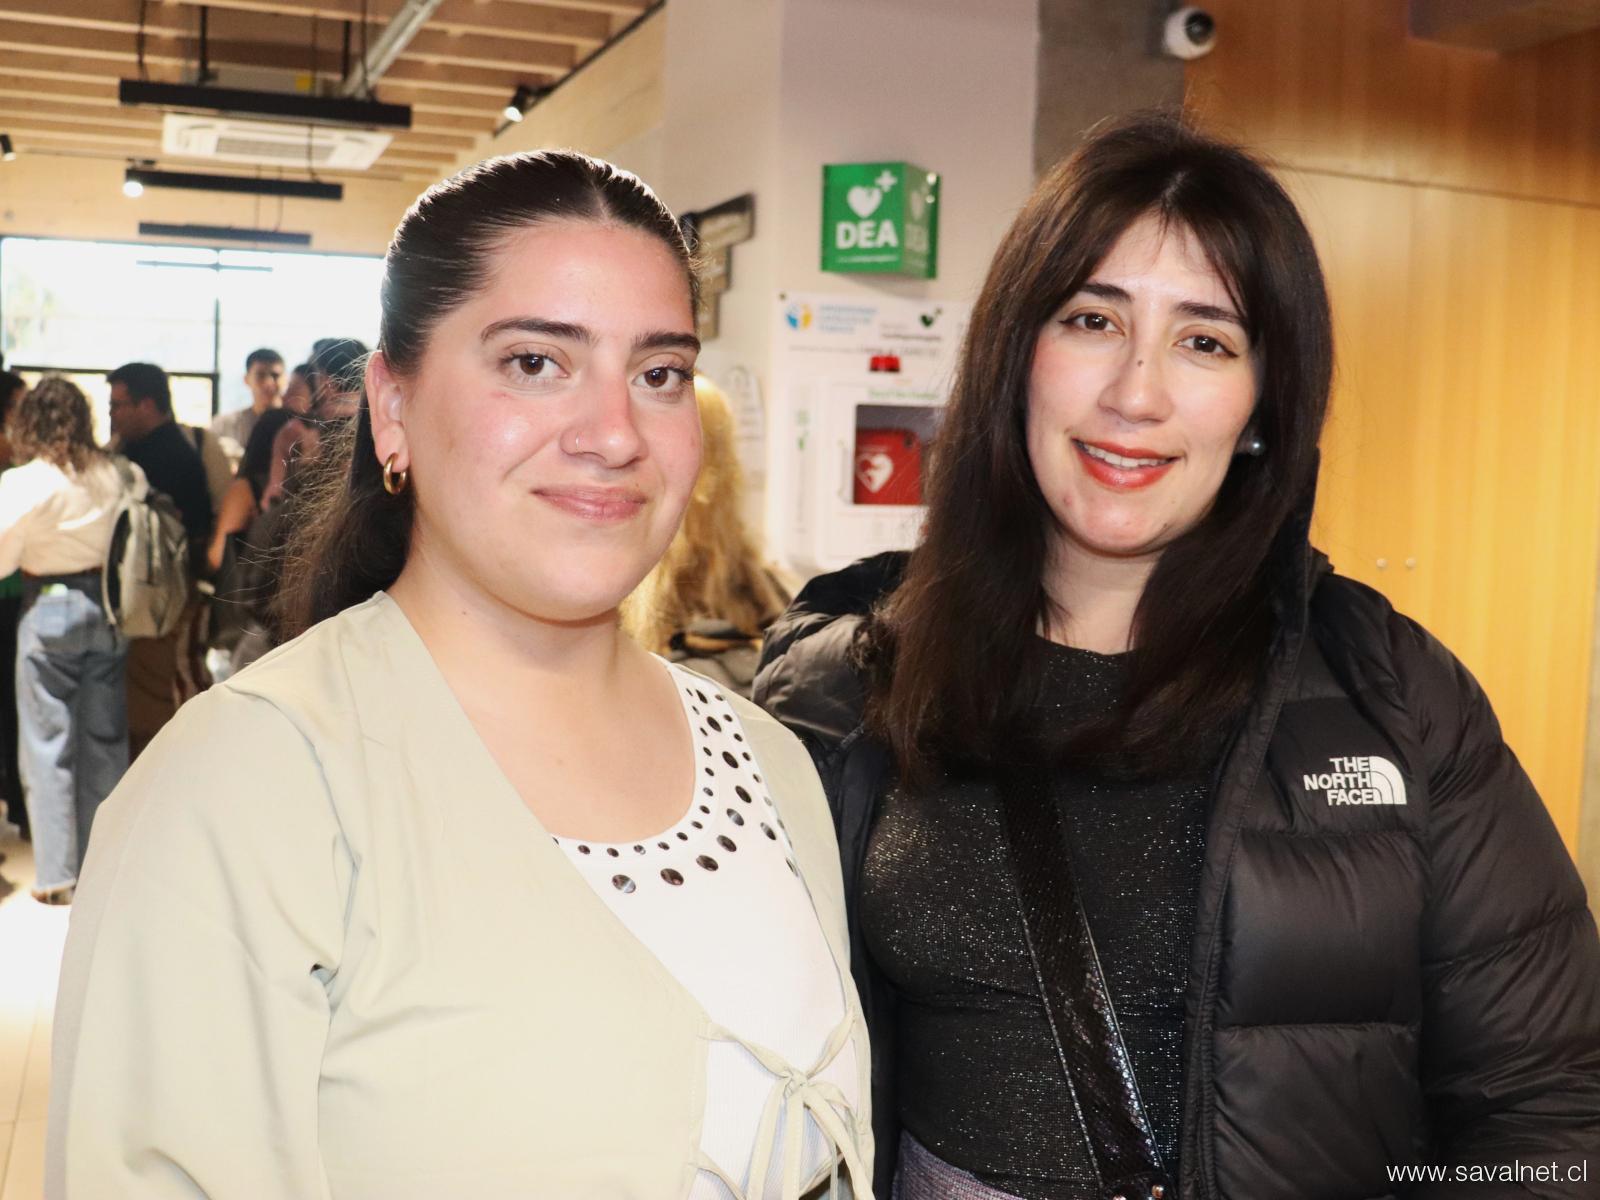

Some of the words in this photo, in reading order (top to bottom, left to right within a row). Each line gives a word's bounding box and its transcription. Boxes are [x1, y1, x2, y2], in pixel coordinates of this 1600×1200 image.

[836, 220, 899, 249] DEA
[1329, 756, 1370, 773] THE
[1303, 771, 1371, 791] NORTH
[1326, 788, 1374, 806] FACE
